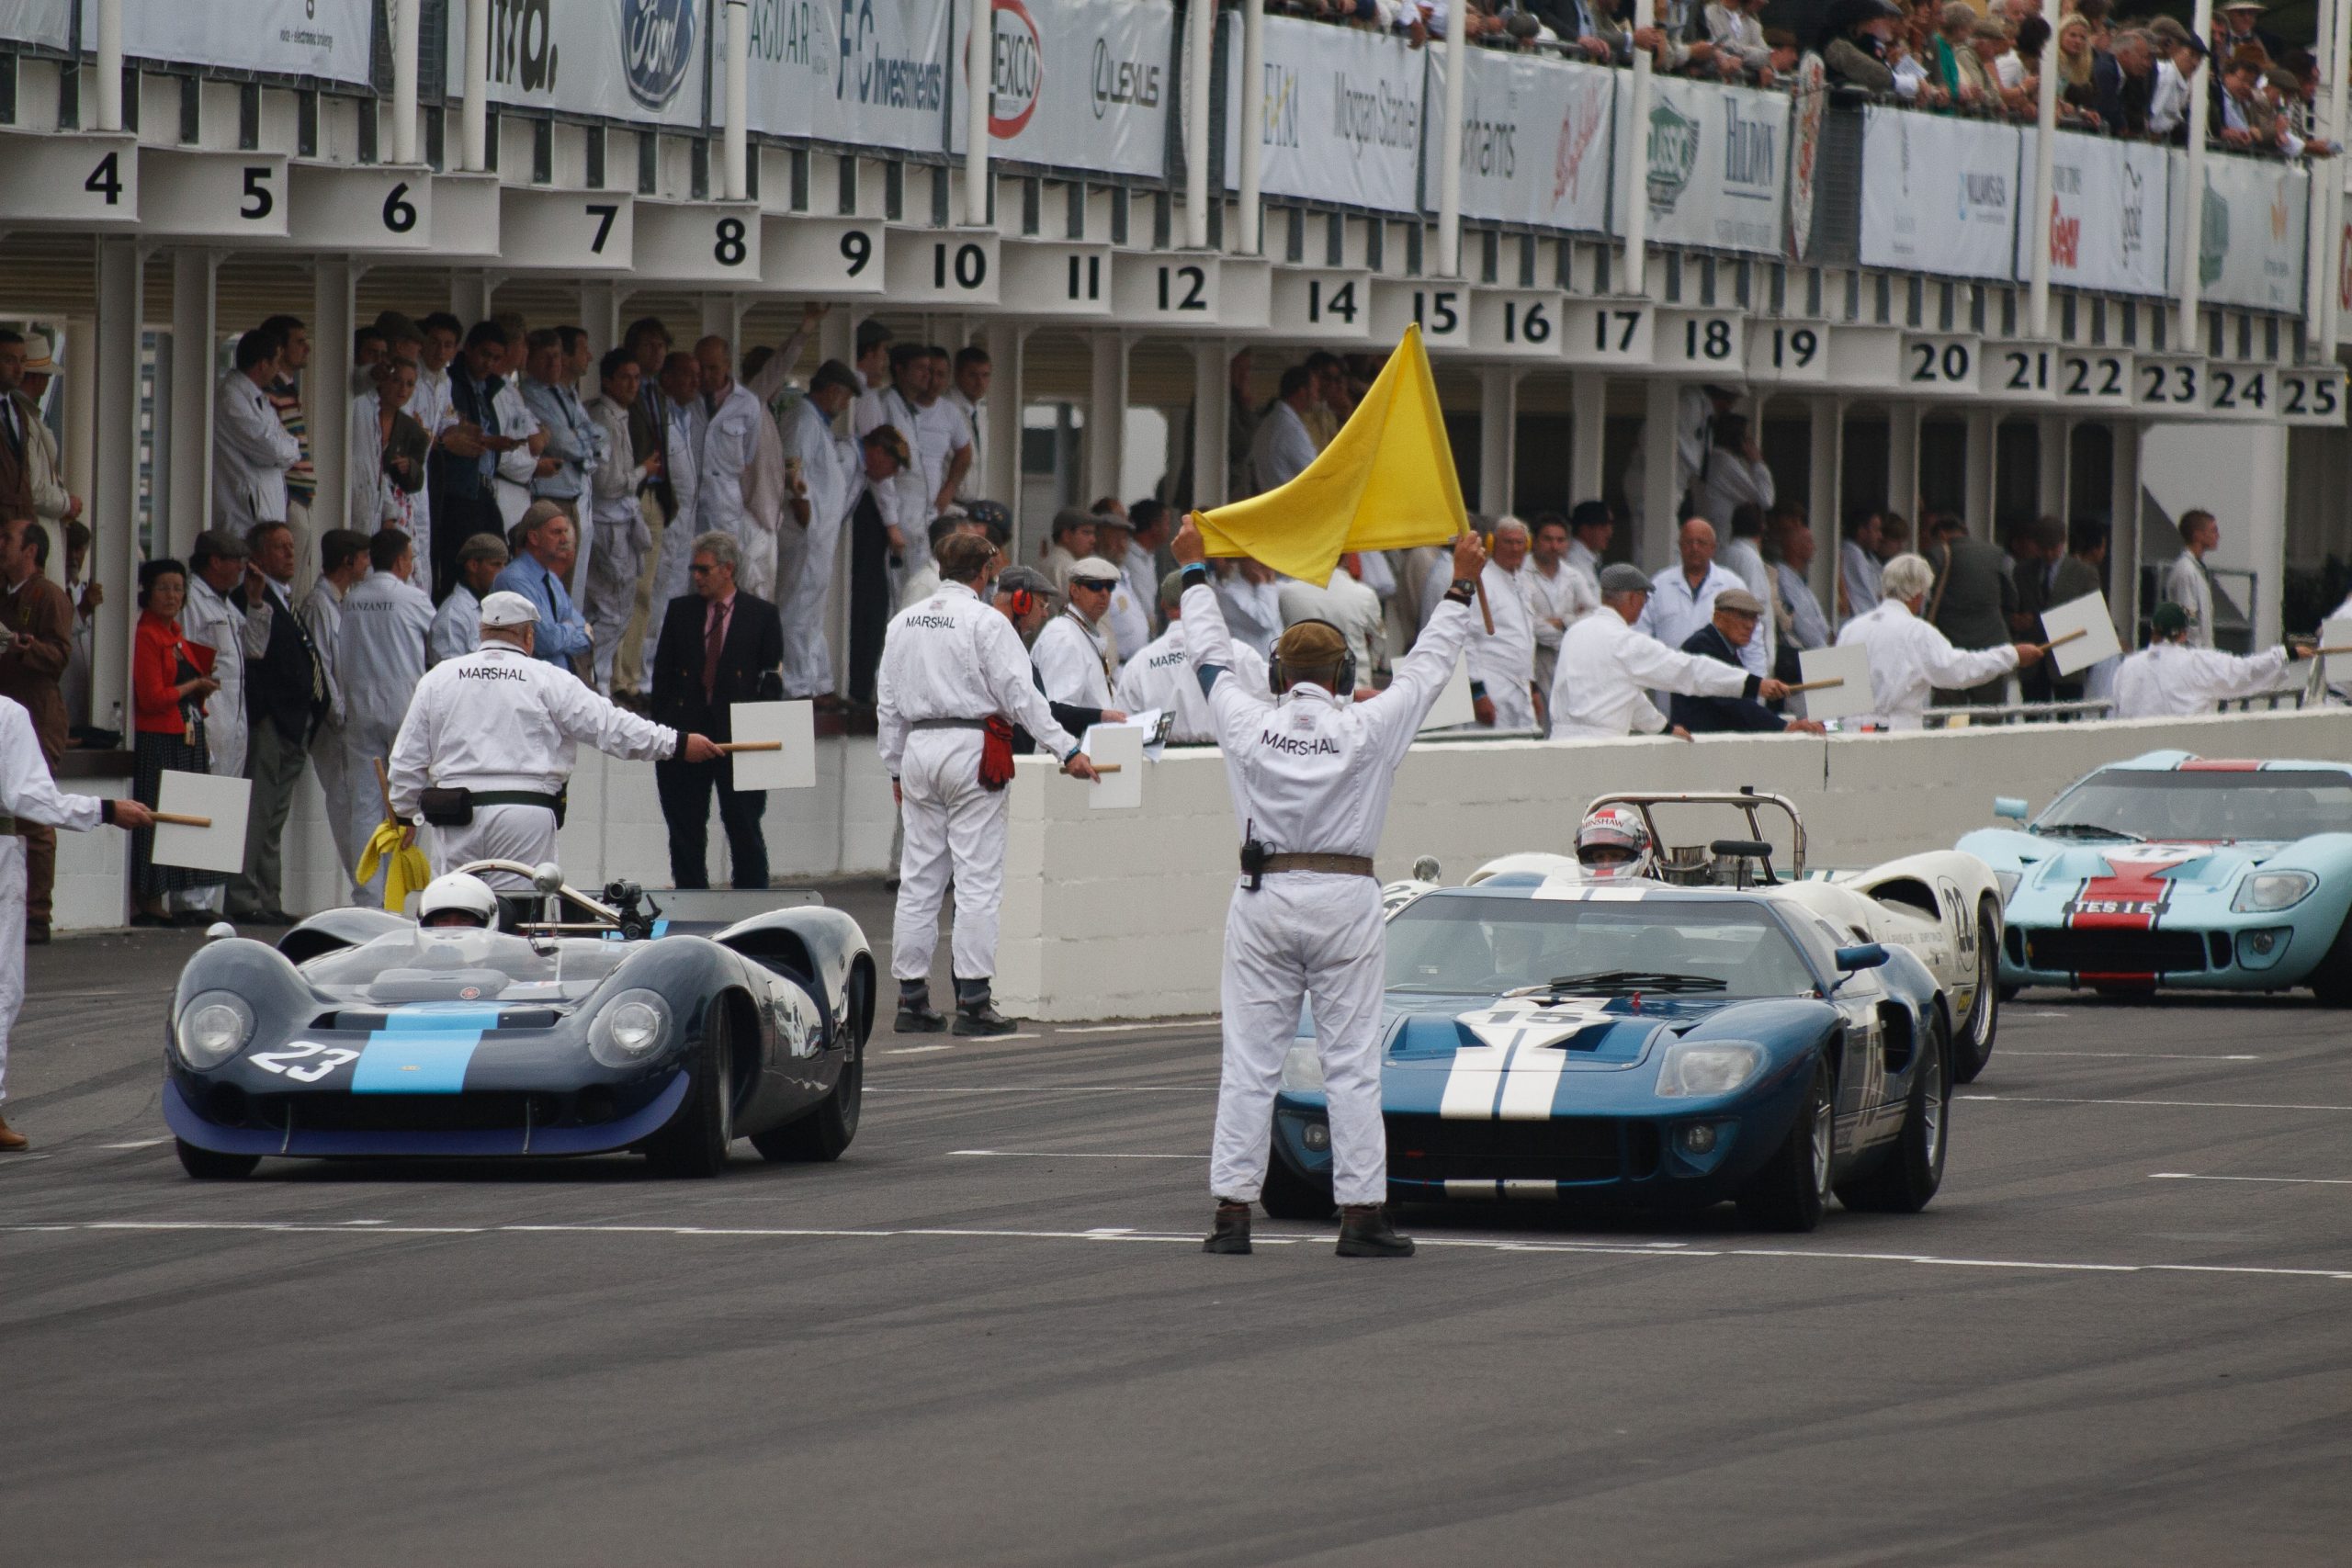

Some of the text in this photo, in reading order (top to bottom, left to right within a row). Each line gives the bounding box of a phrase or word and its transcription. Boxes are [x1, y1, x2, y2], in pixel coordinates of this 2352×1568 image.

[1110, 61, 1159, 107] LEXUS
[85, 152, 122, 205] 4
[241, 167, 273, 220] 5
[382, 182, 417, 233] 6
[585, 205, 619, 254] 7
[715, 218, 746, 266] 8
[840, 230, 872, 277] 9
[934, 243, 987, 289] 10
[1069, 255, 1100, 300] 11
[1158, 266, 1207, 310] 12
[1309, 281, 1357, 323] 14
[1413, 292, 1458, 334] 15
[1504, 301, 1551, 344] 16
[1596, 310, 1642, 352] 17
[1687, 319, 1732, 360] 18
[1772, 329, 1817, 368] 19
[1911, 344, 1969, 381] 20
[2005, 352, 2048, 389] 21
[2065, 358, 2122, 396] 22
[2142, 367, 2197, 403] 23
[2211, 373, 2267, 409] 24
[2283, 379, 2337, 415] 25
[905, 615, 956, 629] MARSHAL
[458, 667, 526, 682] MARSHAL
[1261, 729, 1340, 755] MARSHAL
[1487, 1010, 1585, 1024] 15
[248, 1041, 360, 1083] 23
